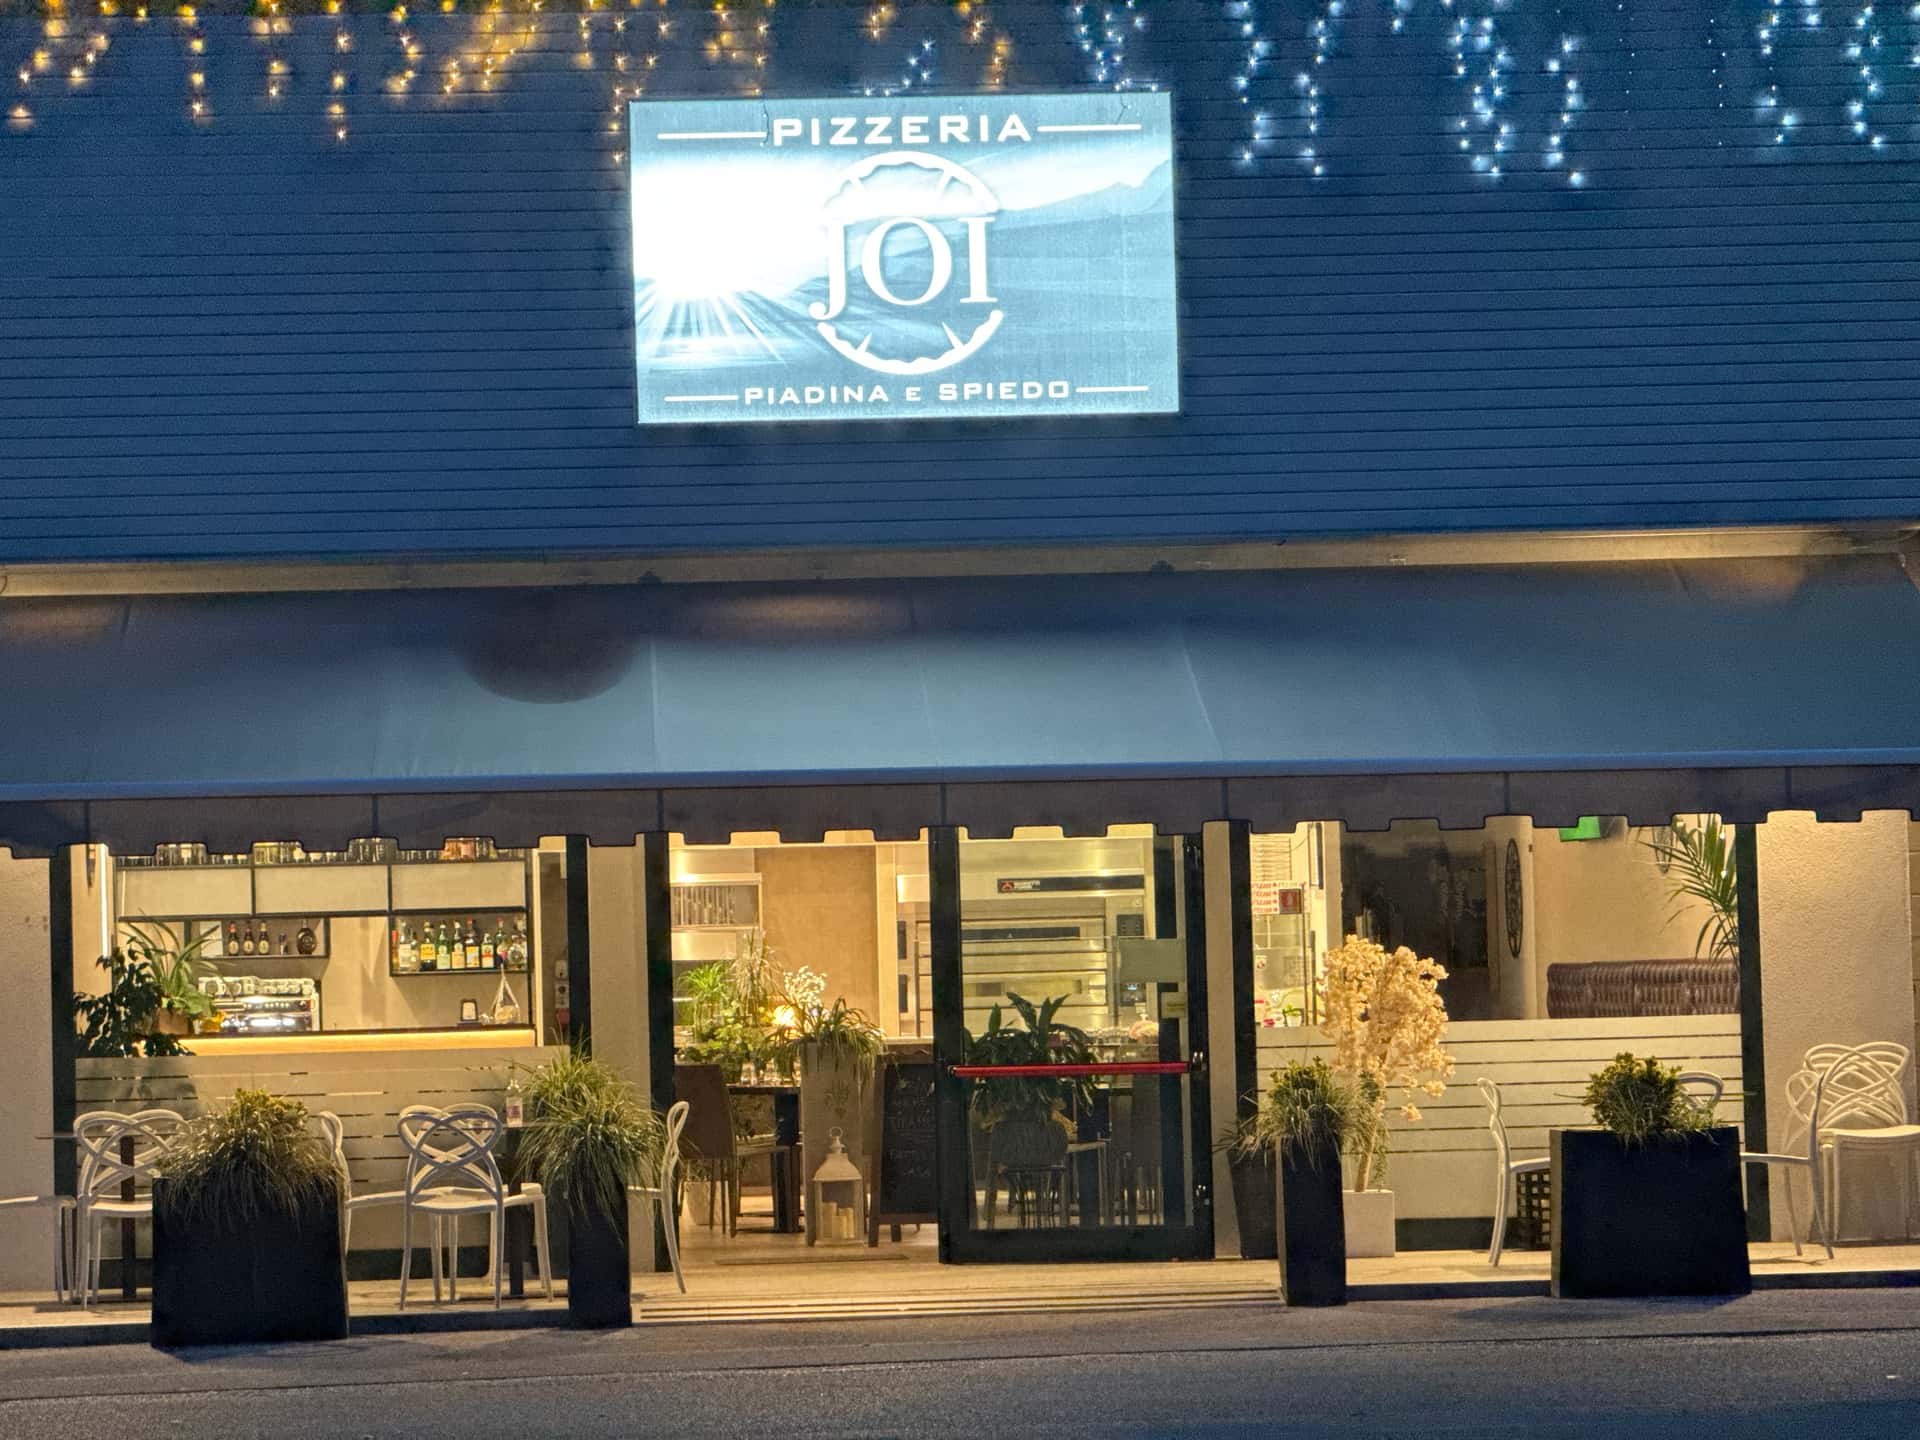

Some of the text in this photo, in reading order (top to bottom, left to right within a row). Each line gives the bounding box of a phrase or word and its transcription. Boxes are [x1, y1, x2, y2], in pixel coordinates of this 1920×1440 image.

[773, 114, 1031, 146] PIZZERIA
[808, 216, 998, 320] JOI
[744, 380, 1069, 405] PIADINA E SPIEDO
